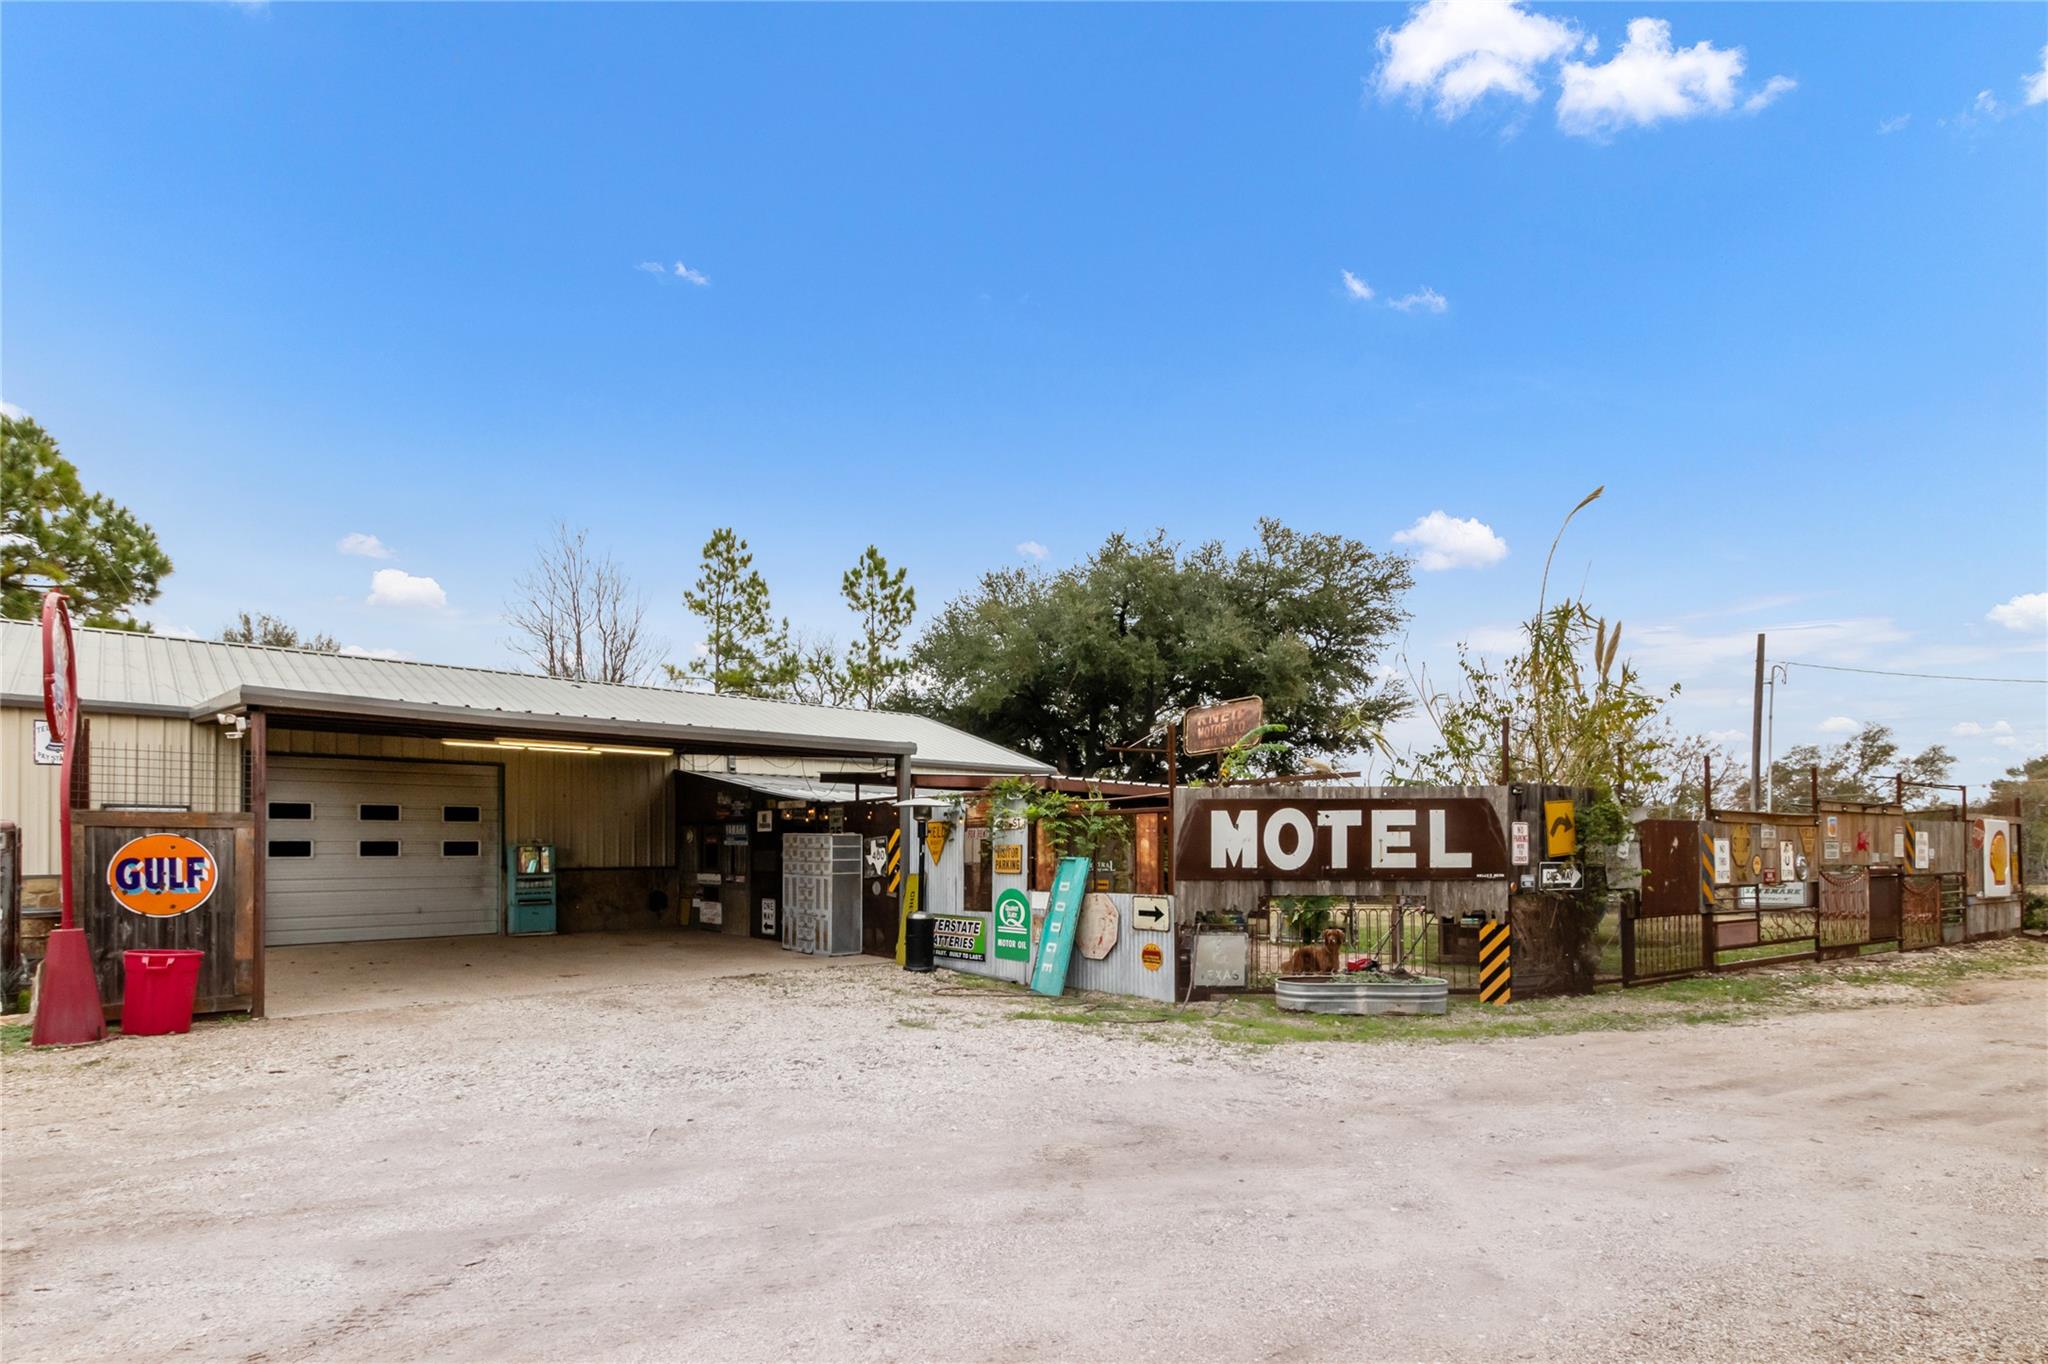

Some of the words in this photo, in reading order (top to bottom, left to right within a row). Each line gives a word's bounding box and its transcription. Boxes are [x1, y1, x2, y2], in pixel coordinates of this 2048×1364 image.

[1211, 808, 1472, 870] MOTEL
[115, 856, 211, 895] GULF
[995, 859, 1020, 871] PARKING
[997, 938, 1017, 948] MOTOR
[1017, 940, 1027, 950] OIL
